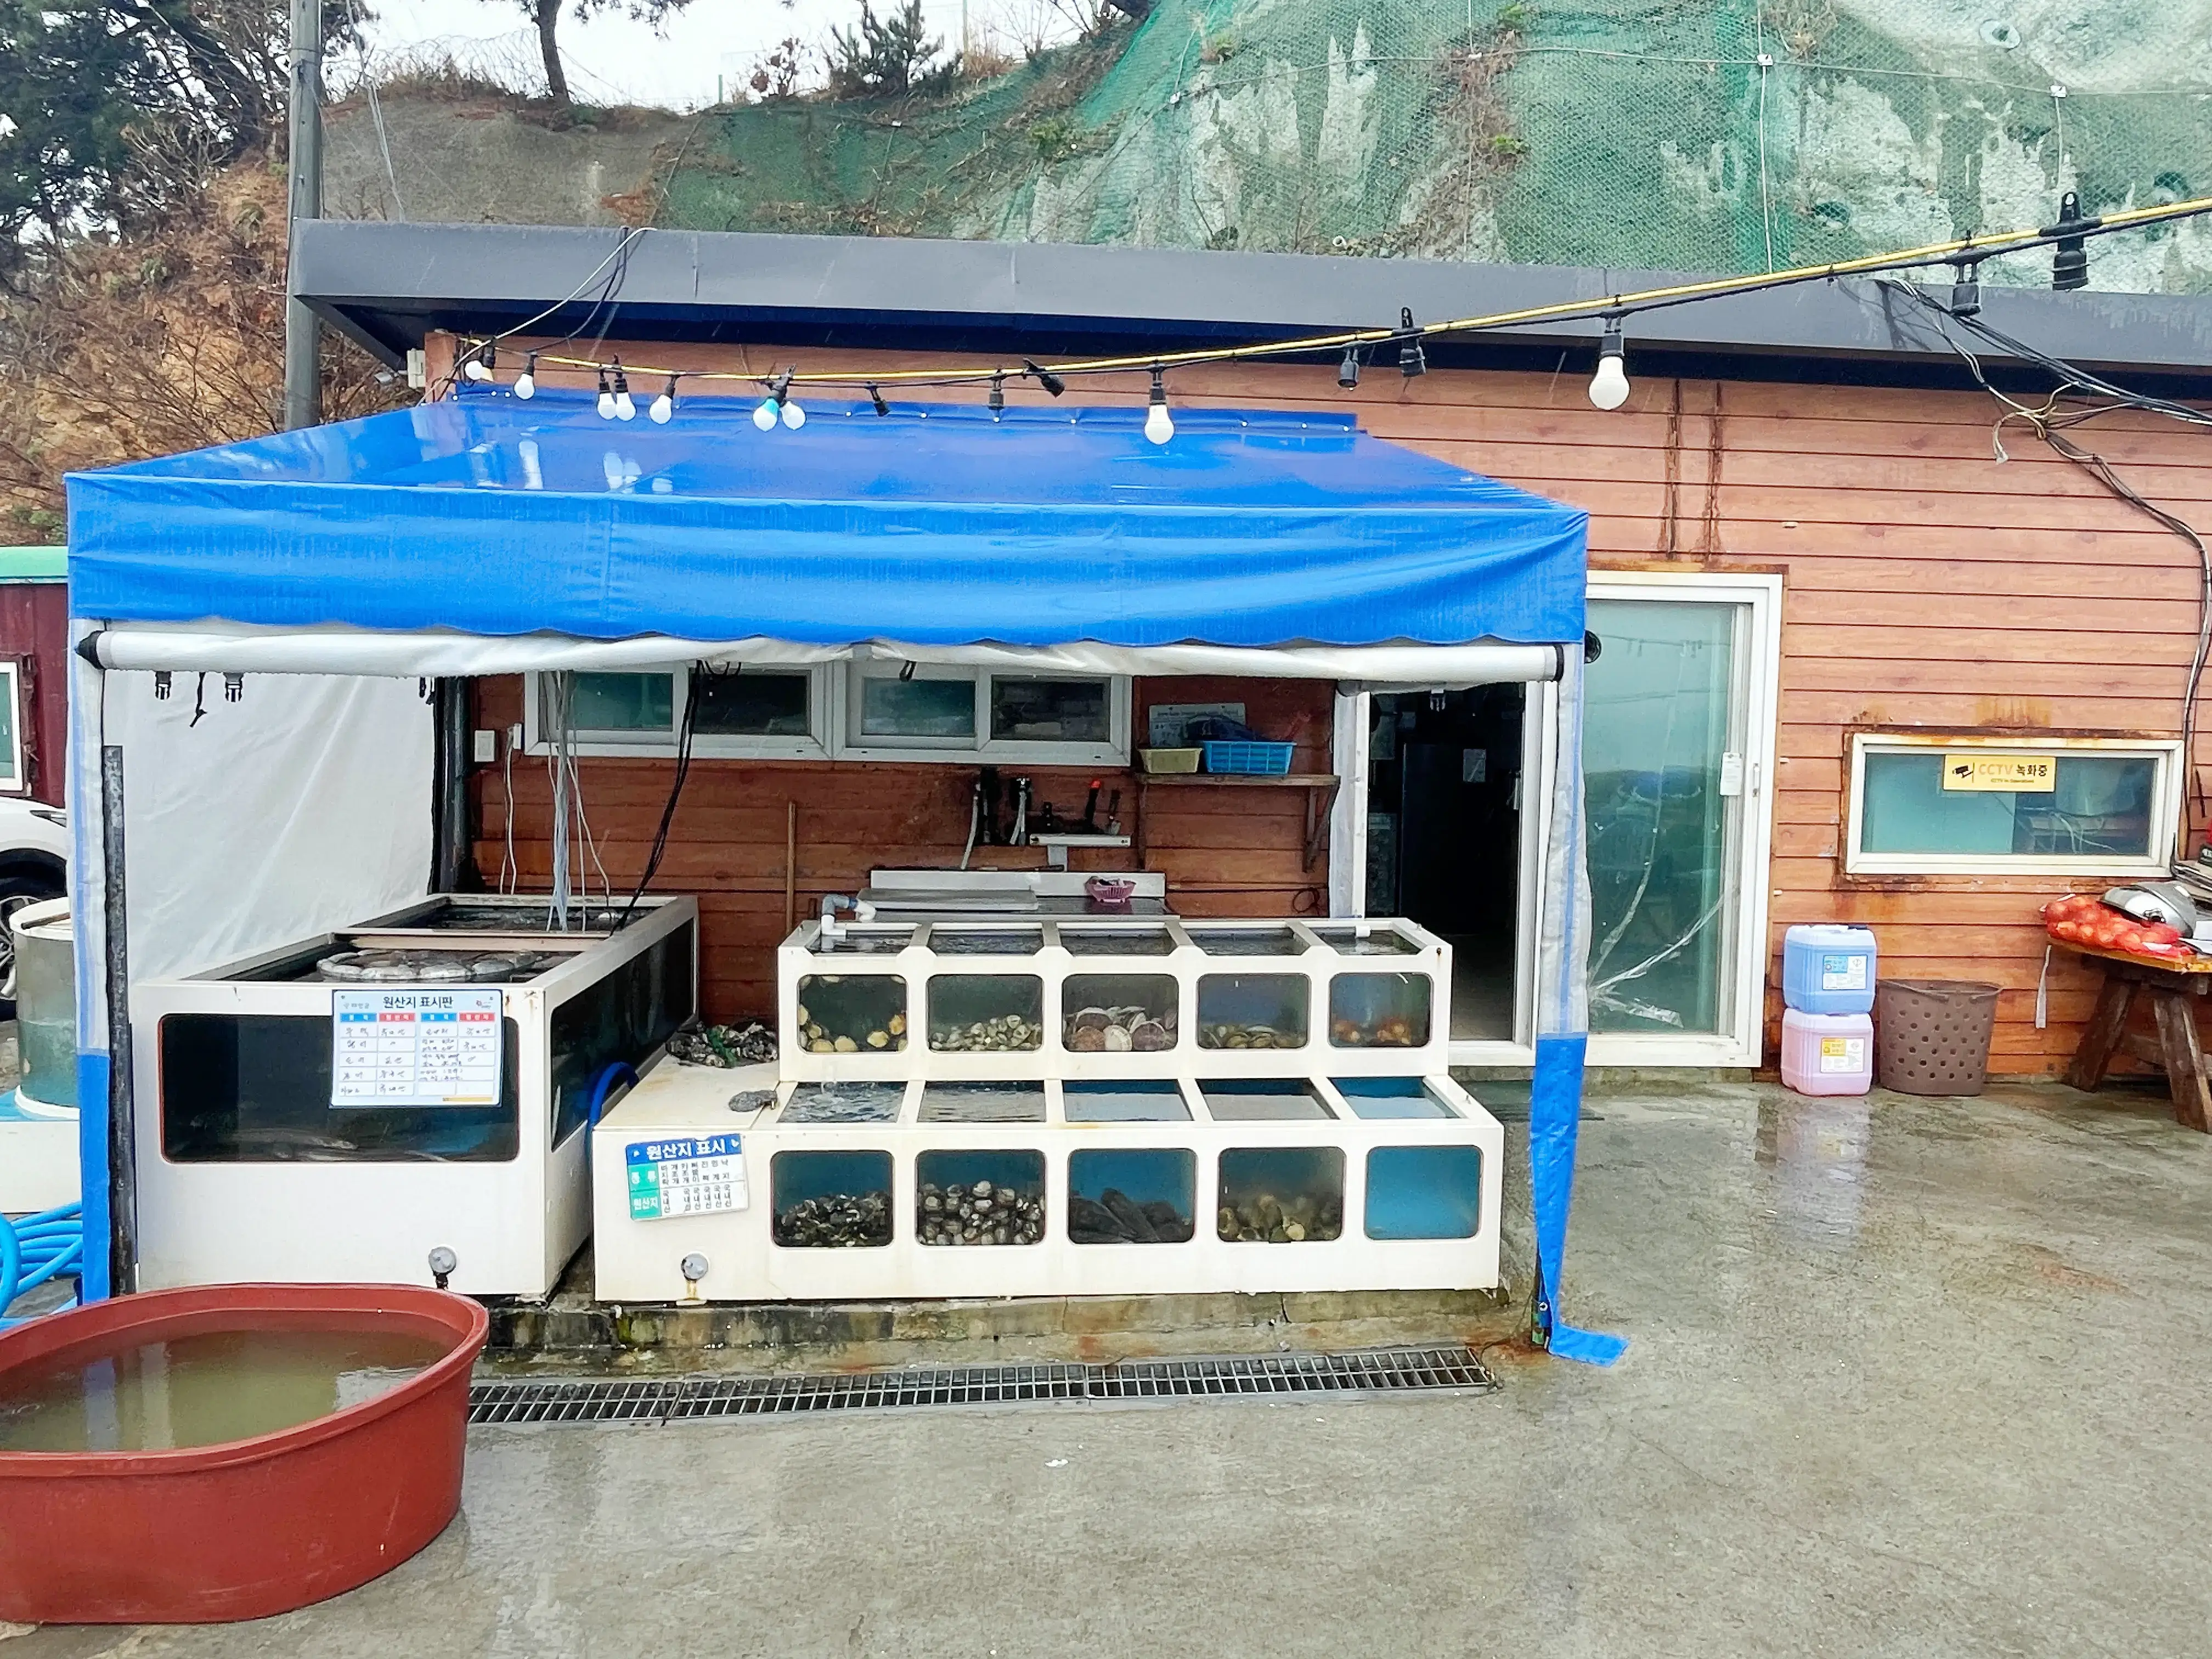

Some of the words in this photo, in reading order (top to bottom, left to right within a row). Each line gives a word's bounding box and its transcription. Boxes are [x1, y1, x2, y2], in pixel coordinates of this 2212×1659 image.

[1978, 764, 2013, 775] CCTV
[2016, 764, 2047, 777] 녹화중
[383, 996, 416, 1009] 원산지
[420, 996, 453, 1009] 표시판
[646, 1142, 691, 1160] 원산지
[696, 1138, 725, 1155] 표시
[633, 1197, 658, 1211] 원산지
